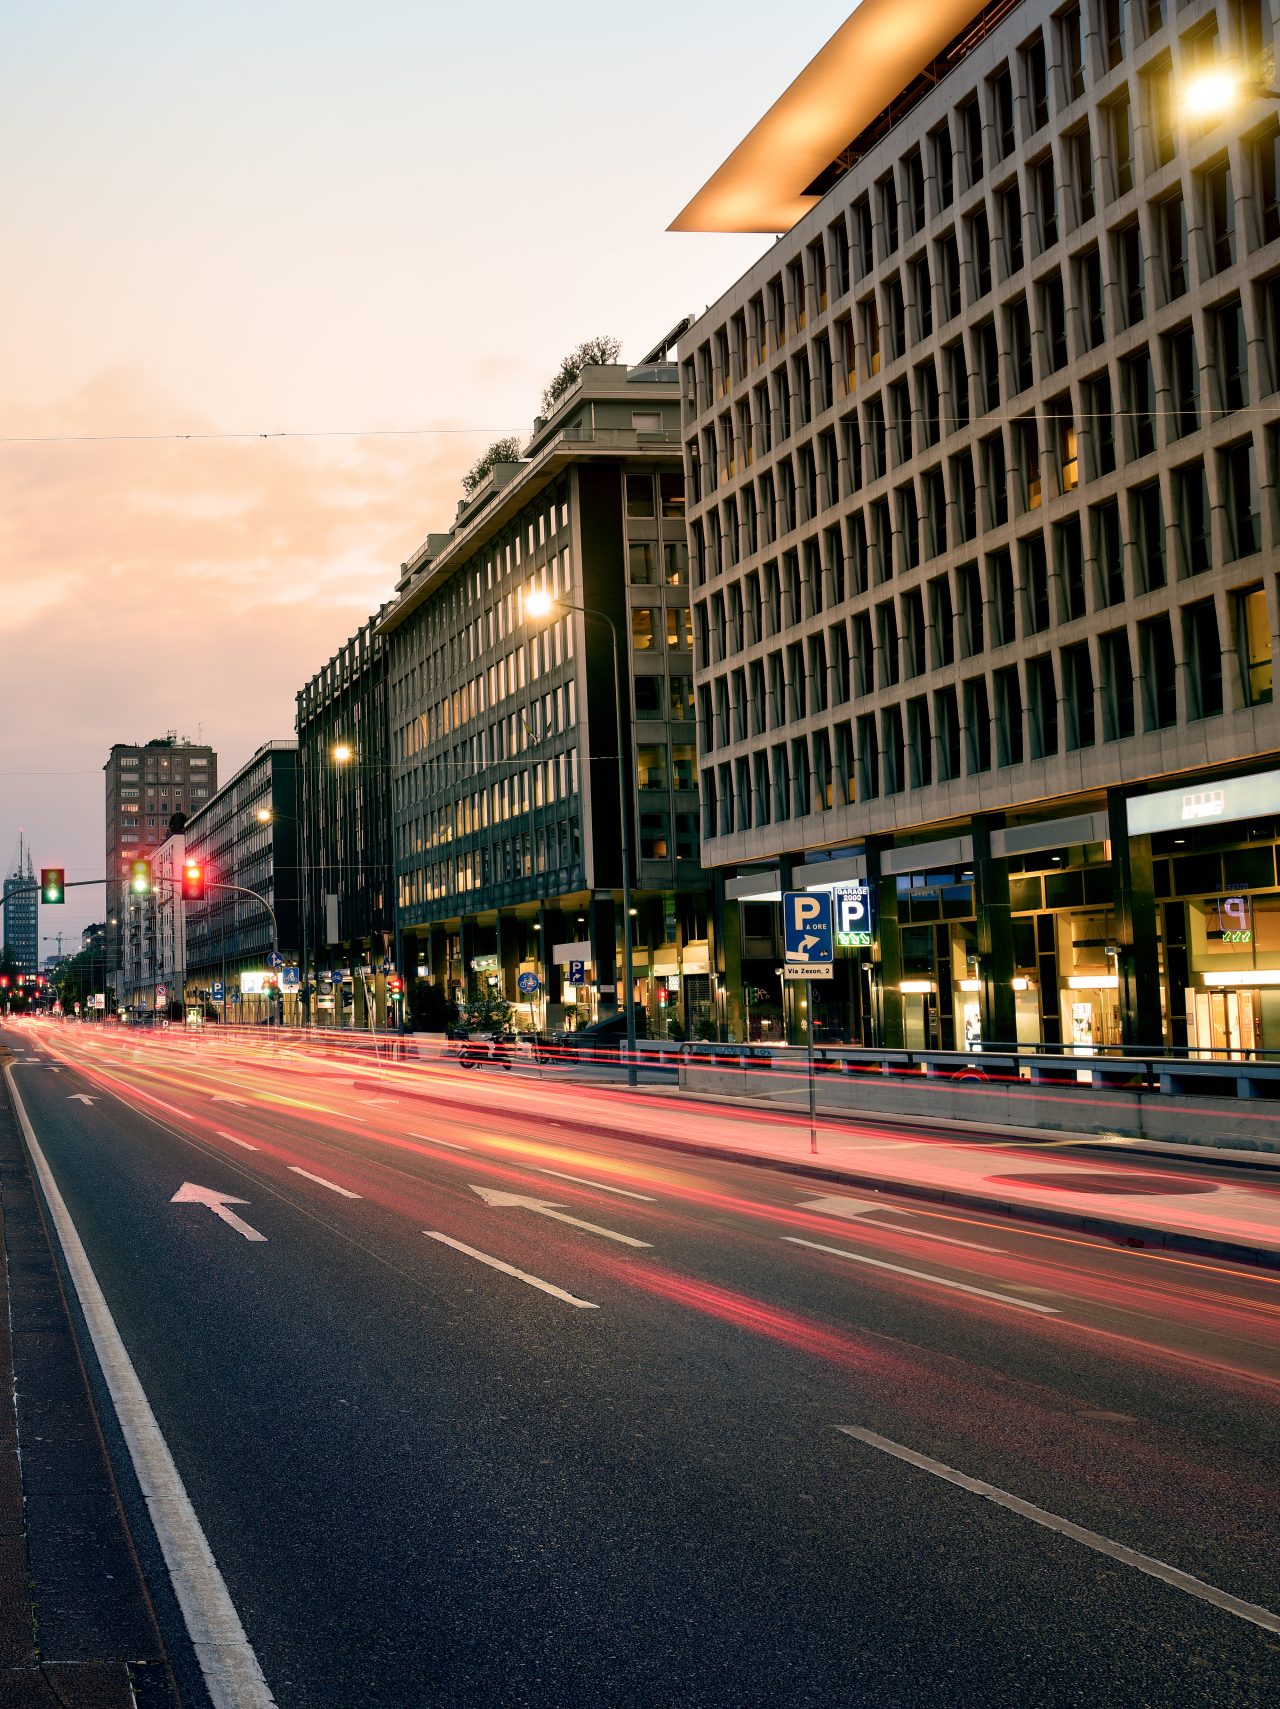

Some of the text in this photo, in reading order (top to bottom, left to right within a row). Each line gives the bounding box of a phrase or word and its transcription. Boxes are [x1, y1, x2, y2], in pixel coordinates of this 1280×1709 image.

[794, 897, 821, 931] P
[841, 901, 864, 931] P
[573, 962, 582, 973] P
[214, 983, 222, 993] P
